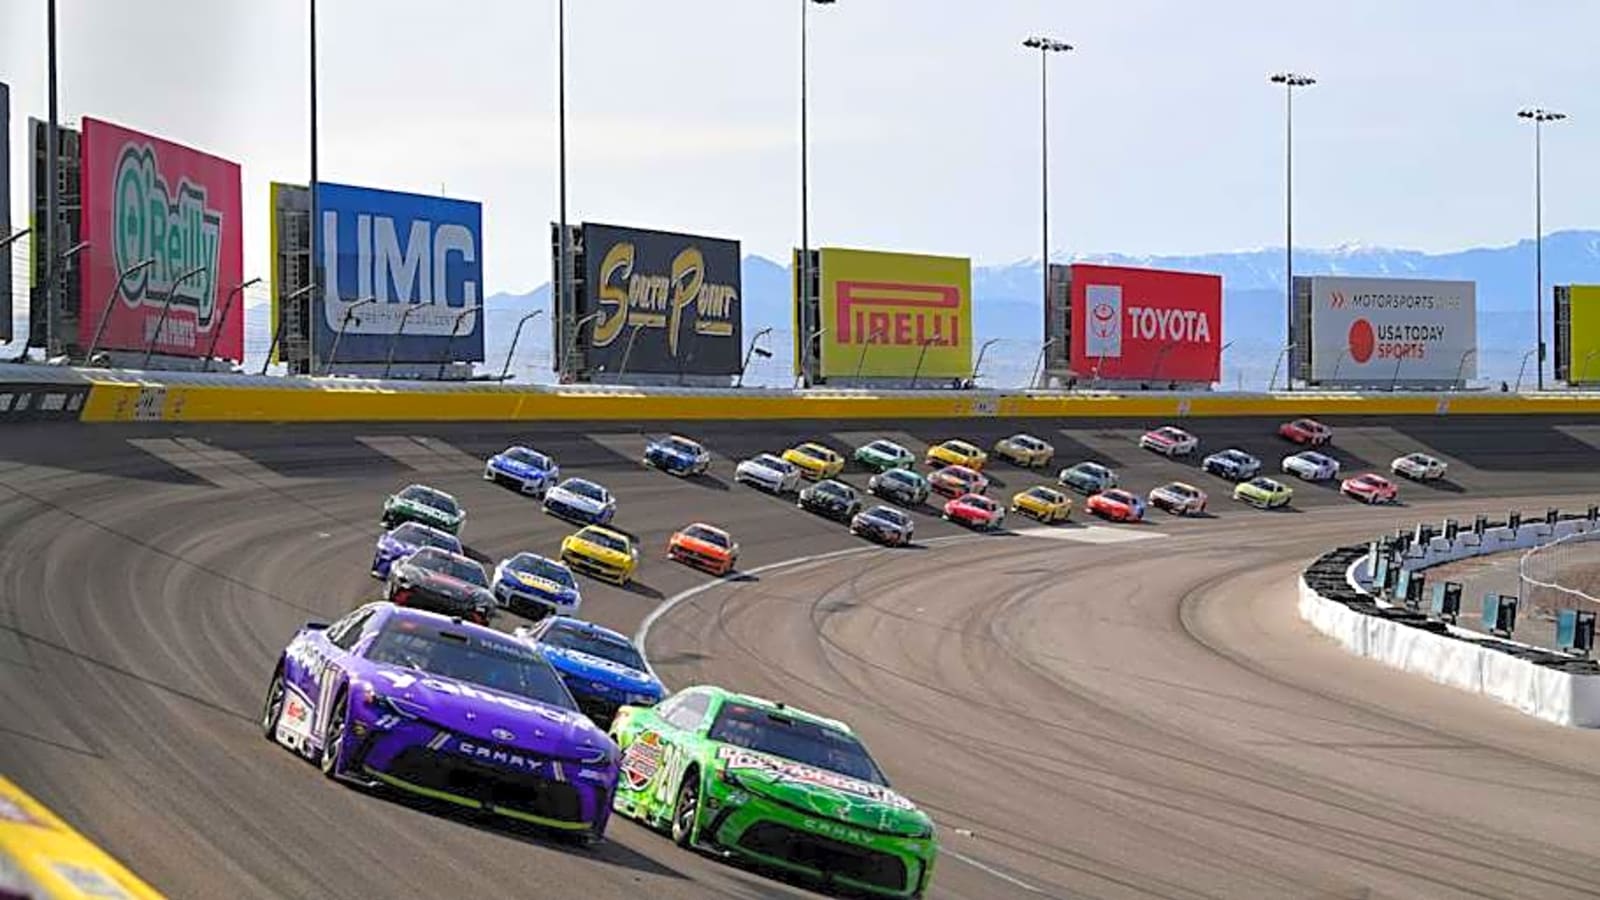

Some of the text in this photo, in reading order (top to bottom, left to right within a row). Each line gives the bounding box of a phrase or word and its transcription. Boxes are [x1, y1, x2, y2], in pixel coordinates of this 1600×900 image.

[115, 150, 219, 325] O'Reilly
[323, 210, 477, 328] UMC
[836, 281, 960, 347] PIRELLI
[1128, 307, 1210, 343] TOYOTA
[1378, 325, 1444, 340] USA TODAY
[1378, 344, 1424, 359] SPORTS
[460, 742, 542, 770] CAMRY
[803, 819, 875, 844] CAMRY
